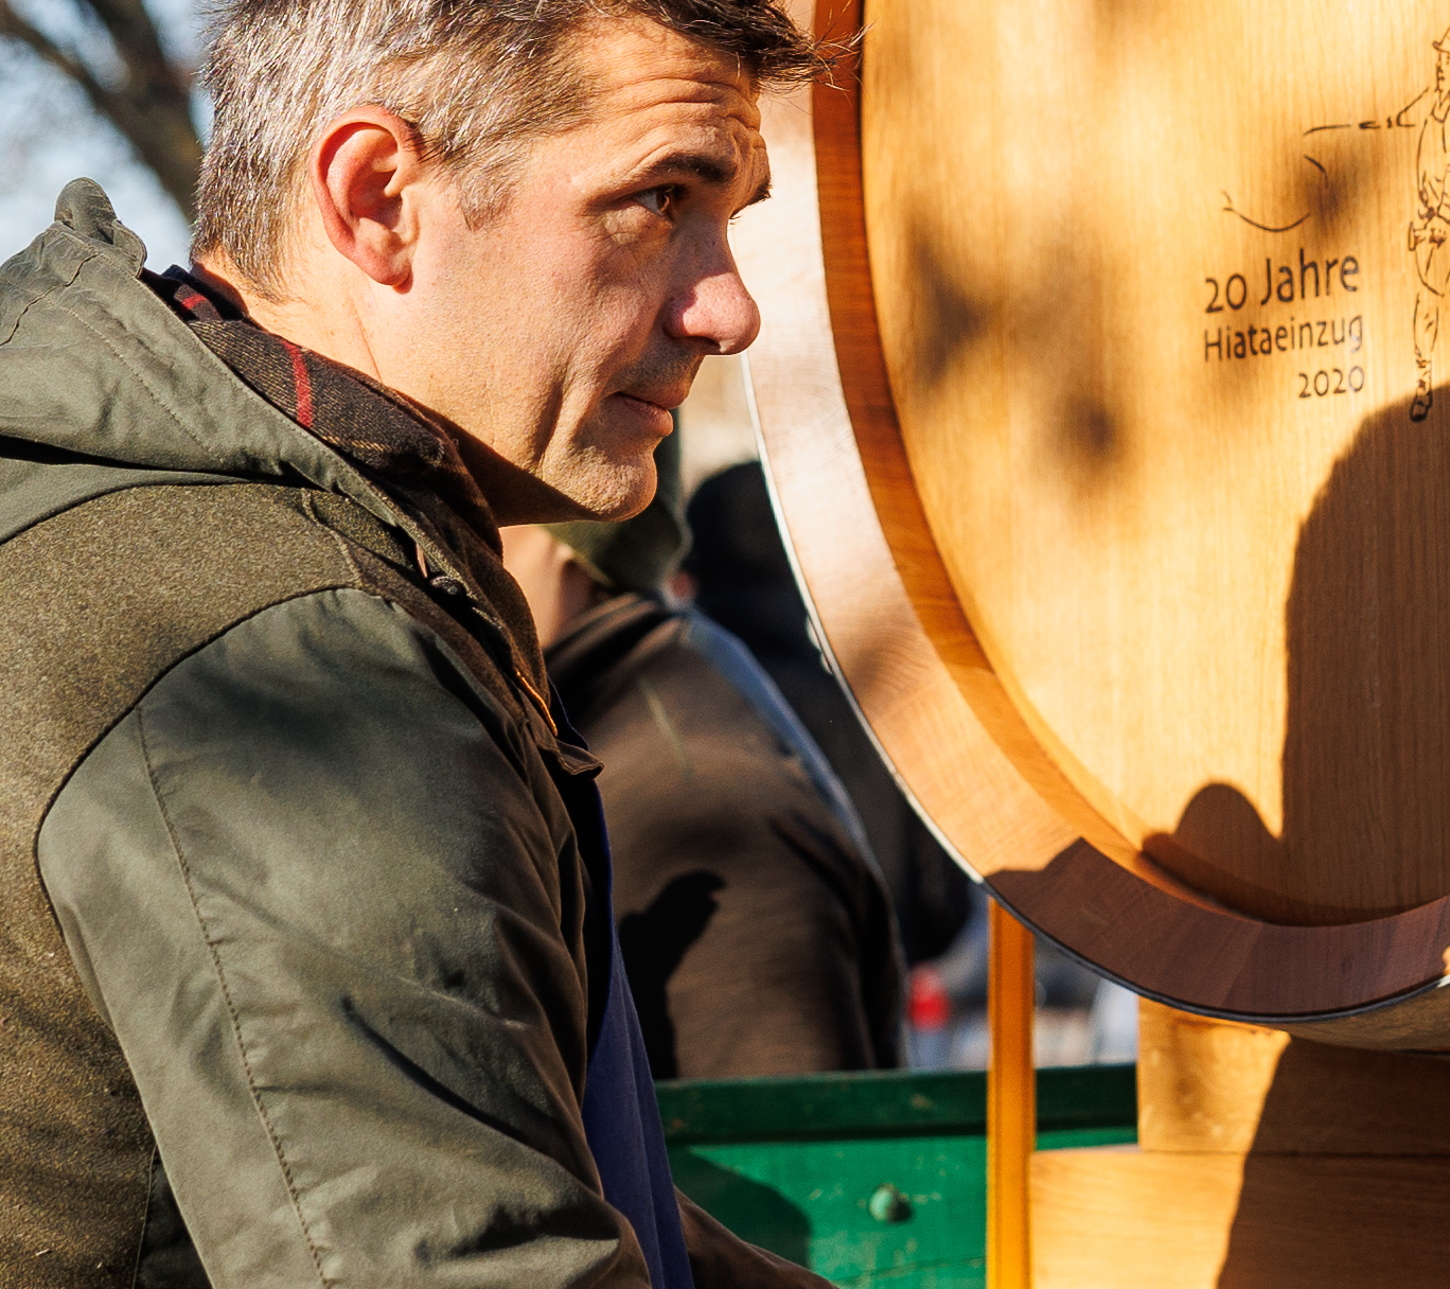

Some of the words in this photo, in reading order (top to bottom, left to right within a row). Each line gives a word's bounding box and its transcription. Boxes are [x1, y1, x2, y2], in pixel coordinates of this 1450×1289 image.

[1204, 273, 1248, 314] 20
[1260, 247, 1360, 306] Jahre
[1204, 314, 1364, 363] Hiataeinzug
[1297, 365, 1365, 399] 2020
